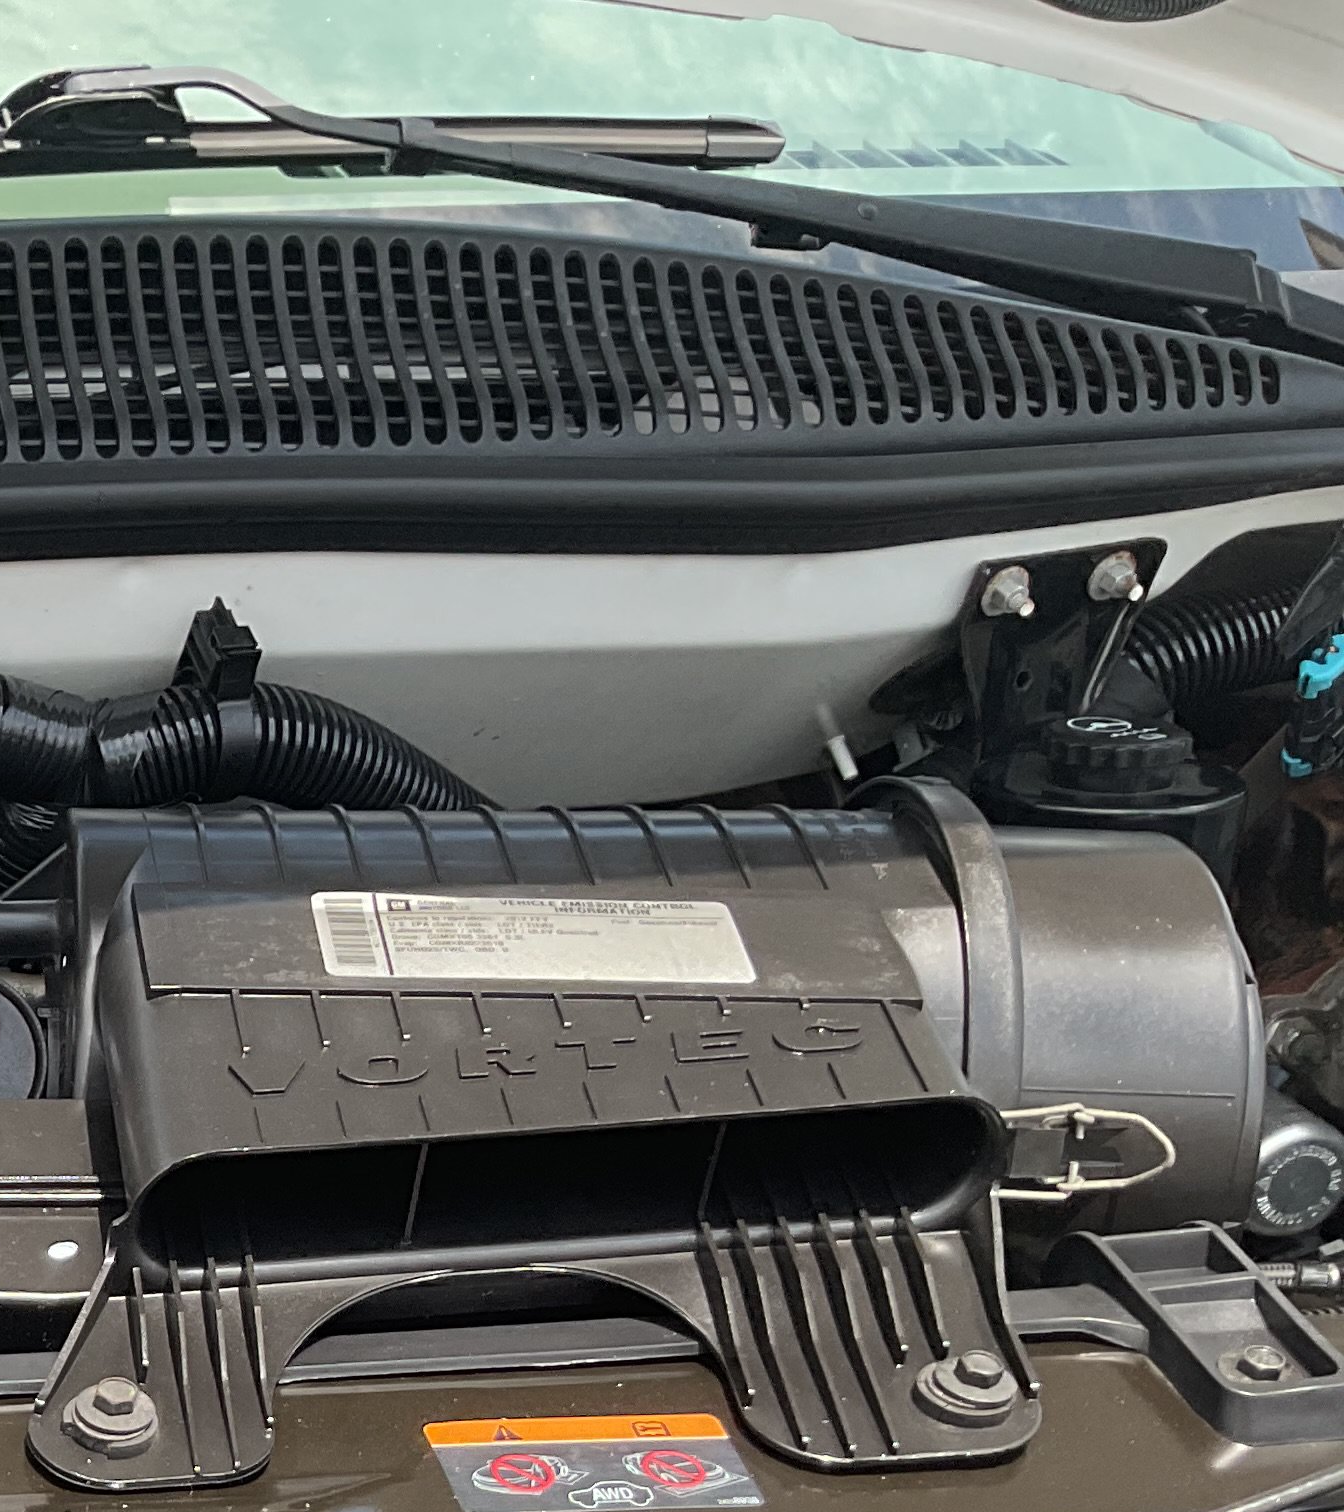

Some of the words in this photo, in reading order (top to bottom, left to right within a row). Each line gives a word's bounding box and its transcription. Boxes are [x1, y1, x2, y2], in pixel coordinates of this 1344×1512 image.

[499, 899, 555, 907] VEHICLE
[561, 901, 628, 909] EMISSION
[632, 902, 695, 910] CONTROL
[554, 906, 651, 915] INFORMATION
[225, 1022, 864, 1096] VORTEC
[592, 1486, 634, 1502] AWD
